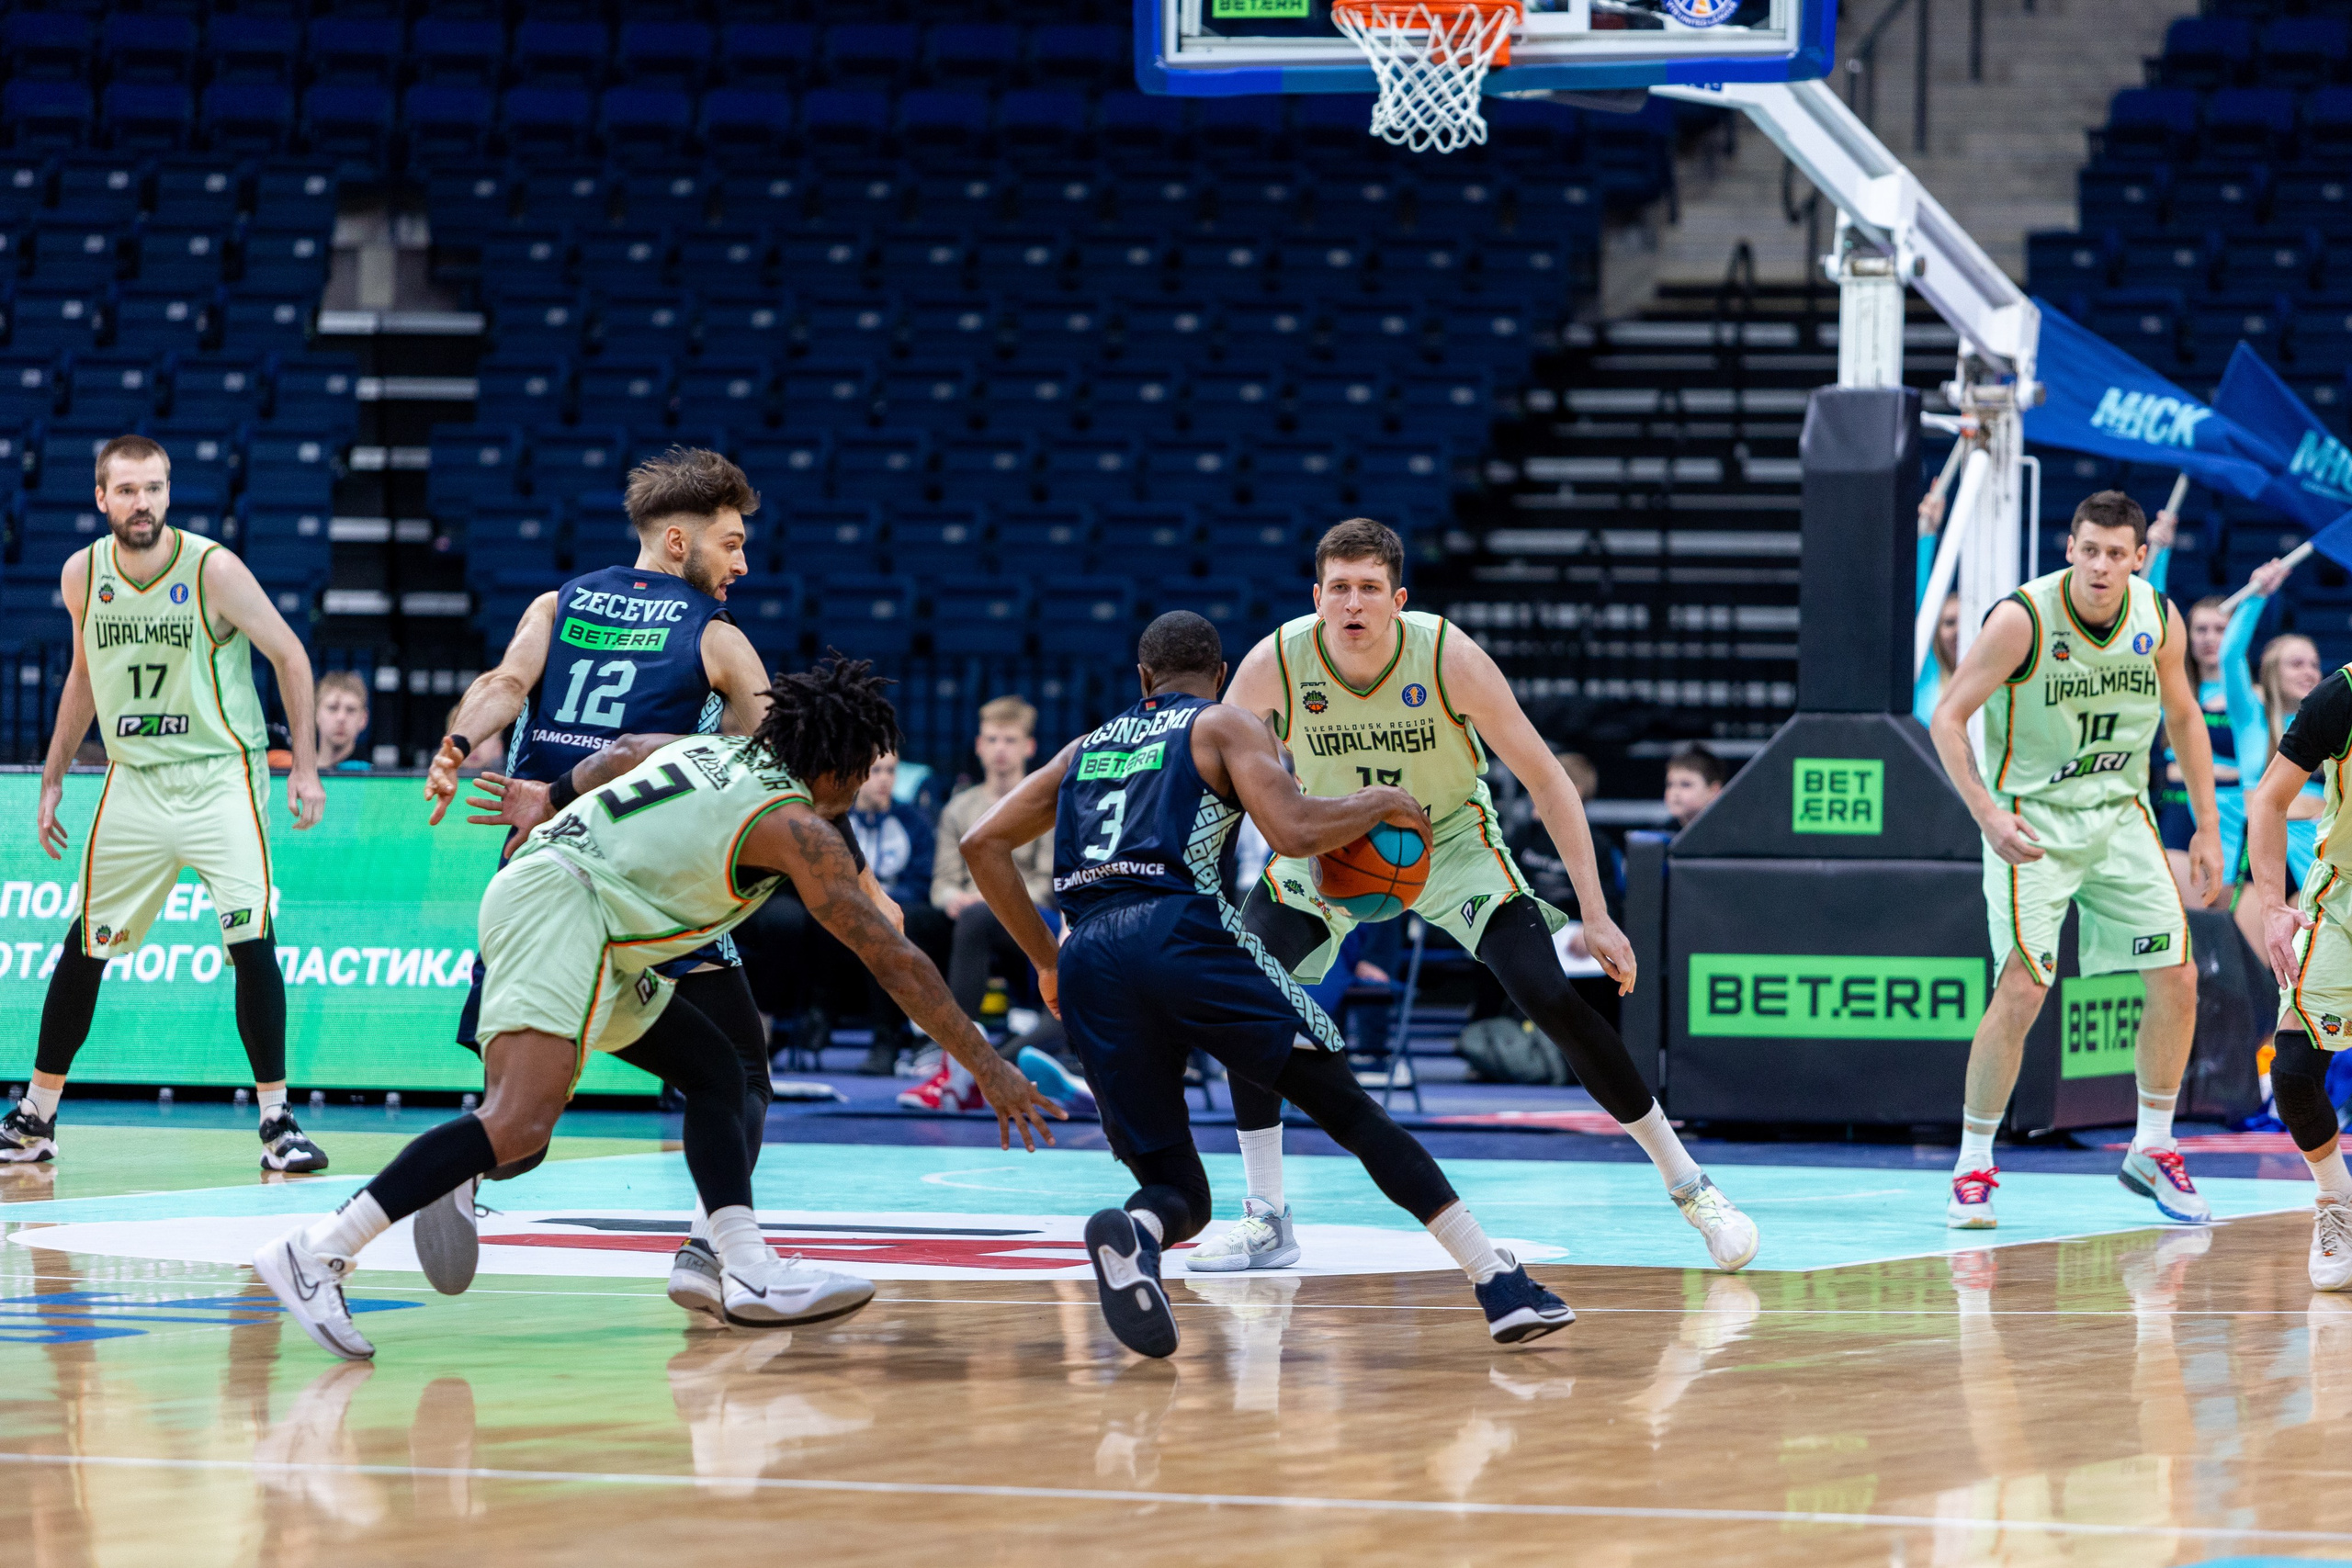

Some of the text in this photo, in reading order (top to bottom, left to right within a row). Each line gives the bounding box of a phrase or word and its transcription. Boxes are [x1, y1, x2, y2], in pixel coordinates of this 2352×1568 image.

[569, 586, 688, 622] ZECEVIC
[96, 621, 193, 651] URALMASH
[128, 663, 168, 699] 17
[554, 659, 638, 728] 12
[2045, 671, 2155, 706] URALMASH
[1304, 717, 1434, 732] SVERDLOVSK REGION
[1306, 725, 1436, 757] URALMASH
[2077, 713, 2119, 750] 10
[594, 761, 696, 824] 3
[1804, 770, 1872, 794] BET
[1084, 789, 1126, 861] 3
